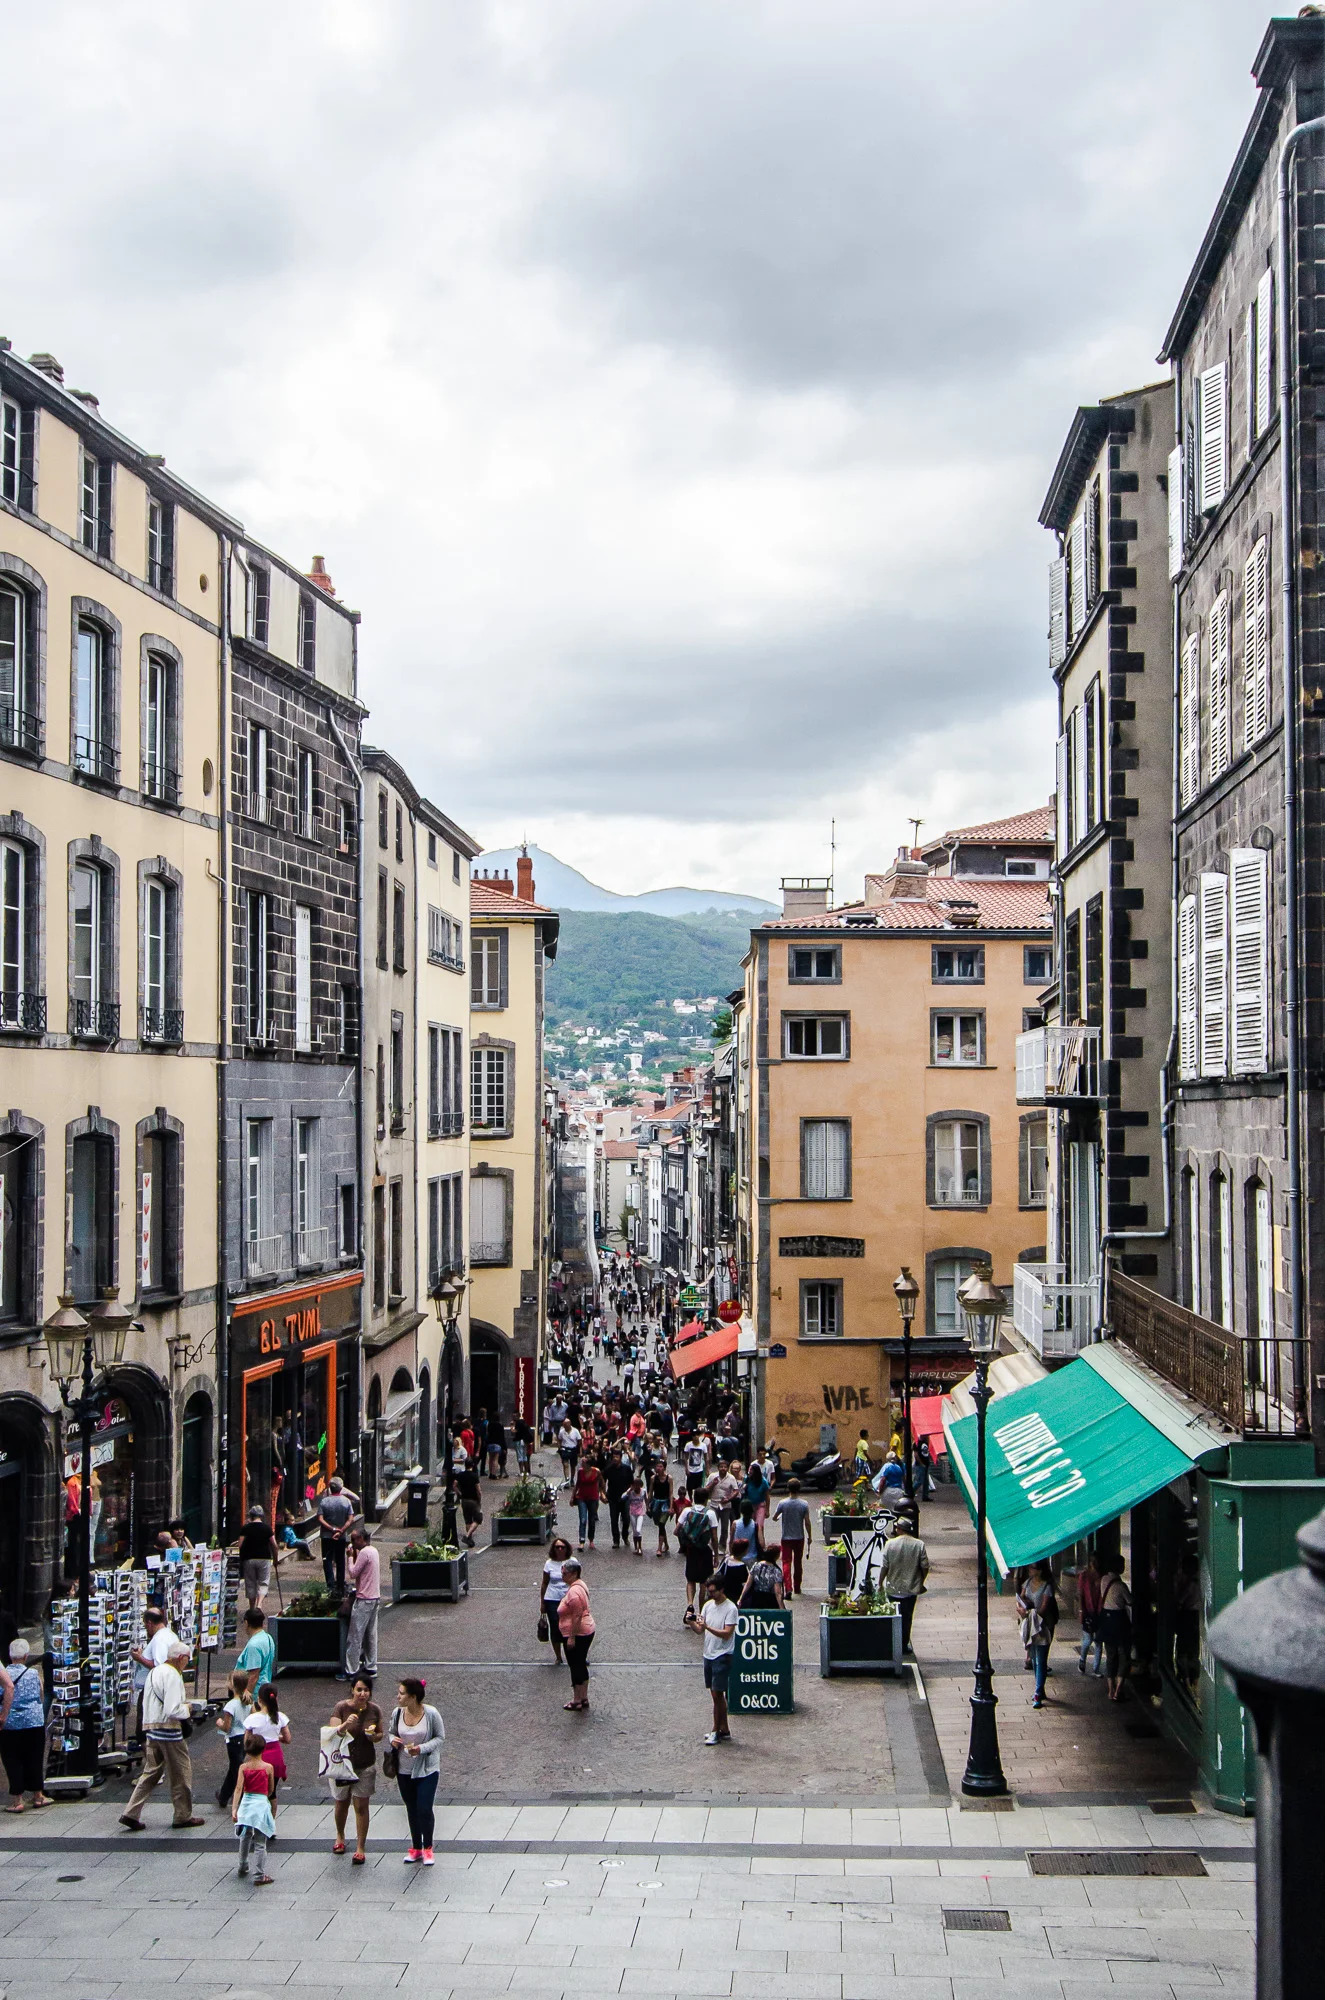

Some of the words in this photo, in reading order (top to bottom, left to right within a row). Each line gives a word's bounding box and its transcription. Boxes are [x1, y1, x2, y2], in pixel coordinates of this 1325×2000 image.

[261, 1319, 281, 1354] EL
[1027, 1469, 1086, 1509] CO
[735, 1615, 785, 1637] Olive
[741, 1638, 778, 1660] Oils
[740, 1672, 780, 1685] tasting
[740, 1694, 780, 1709] O&CO.
